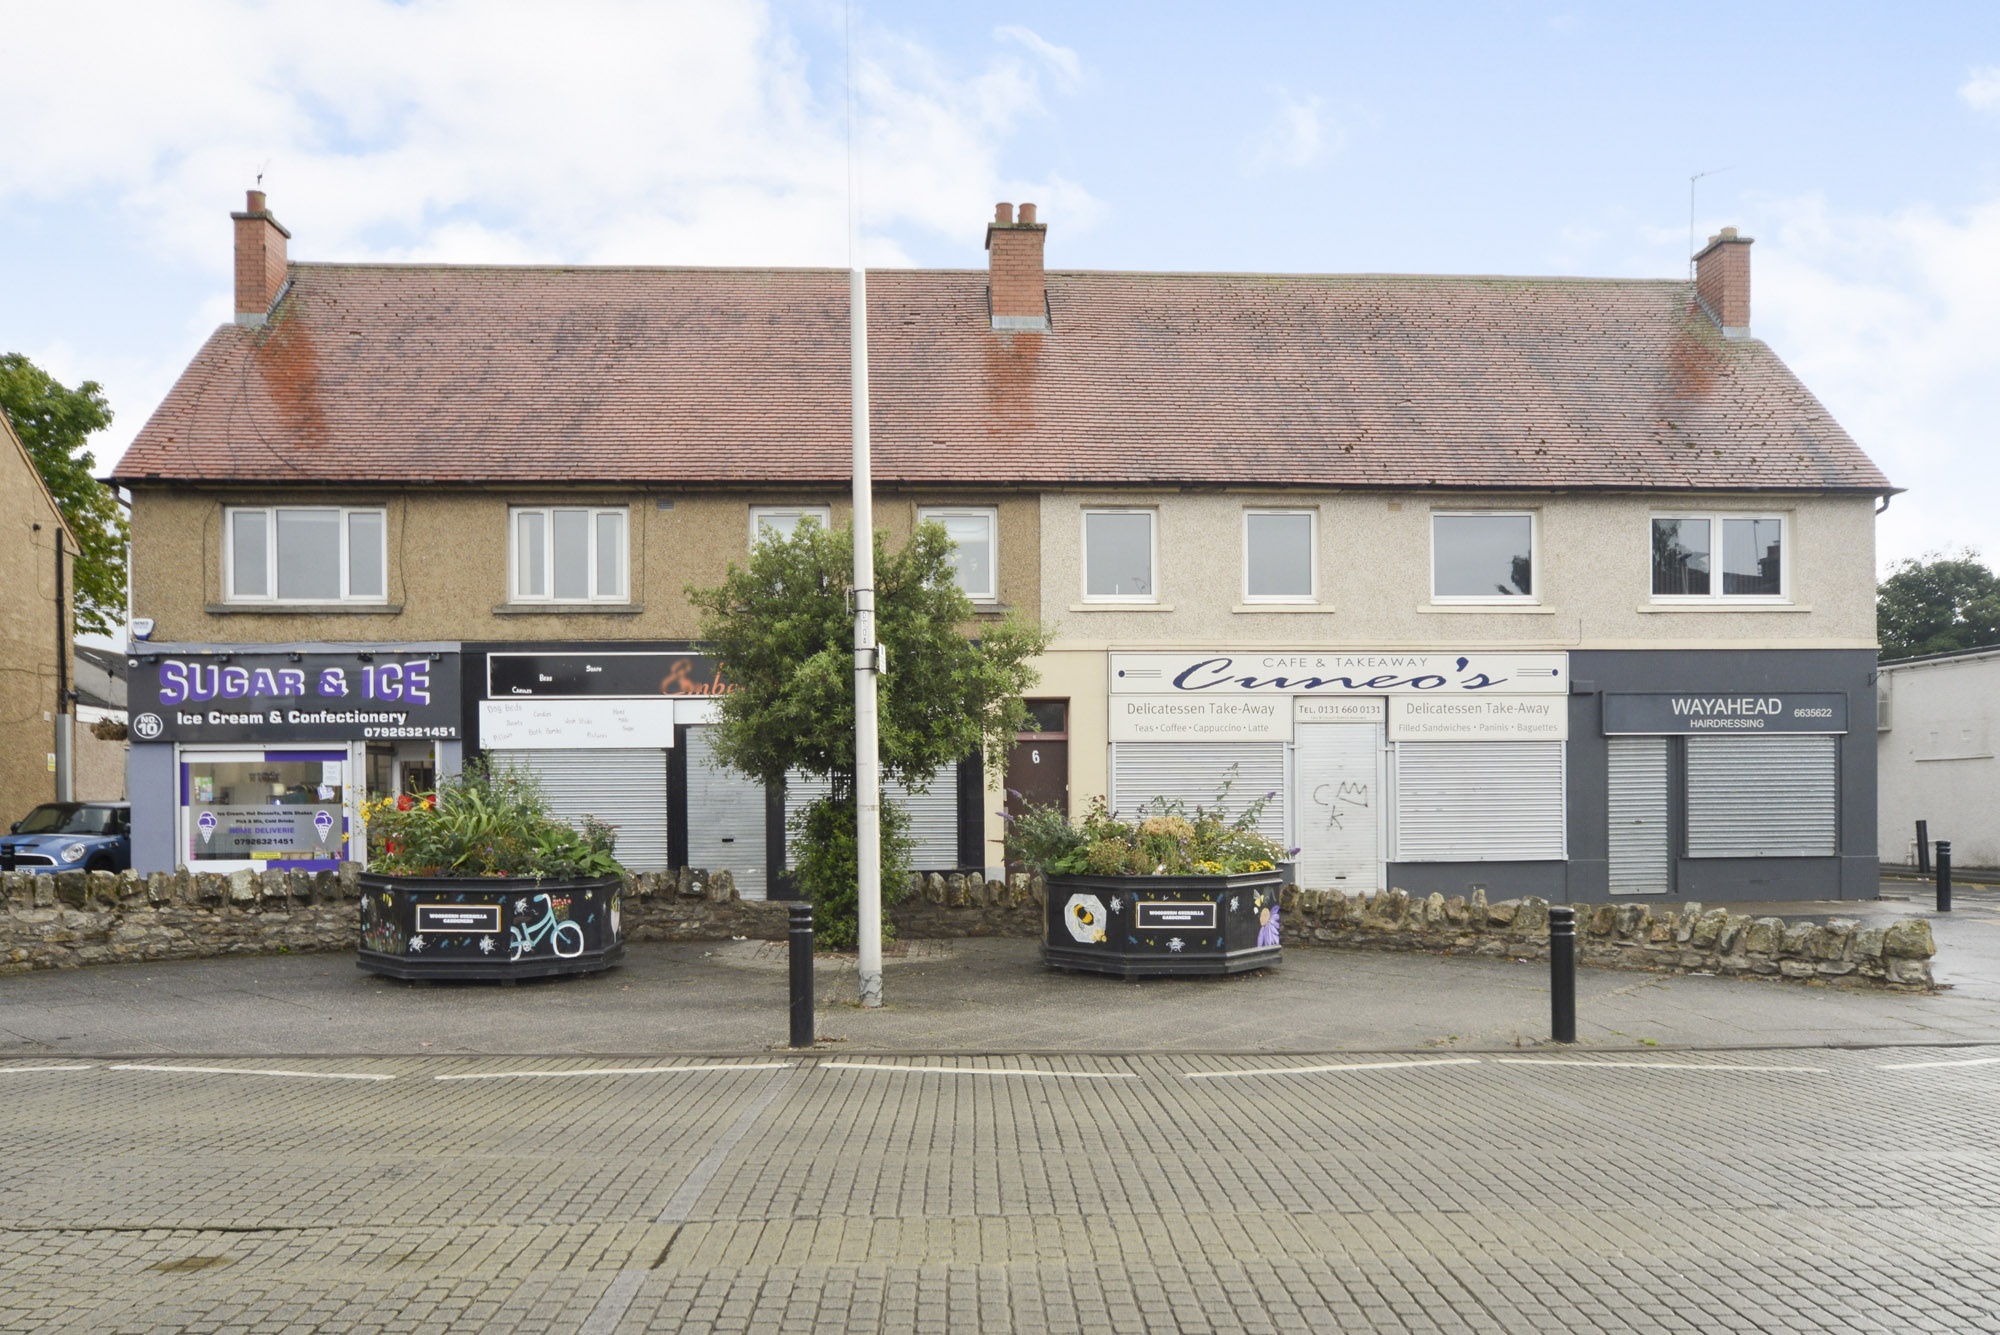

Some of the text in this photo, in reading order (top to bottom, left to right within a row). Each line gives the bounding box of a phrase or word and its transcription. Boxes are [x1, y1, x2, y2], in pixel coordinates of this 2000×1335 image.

[1263, 657, 1428, 668] CAFE & TAKEAWAY
[1172, 656, 1509, 691] Cuneo's
[159, 659, 430, 706] SUGAR & ICE
[1127, 702, 1275, 717] Delicatessen Take-Away
[1318, 705, 1339, 714] 0131
[1341, 705, 1358, 714] 660
[1360, 705, 1381, 714] 0131
[1406, 702, 1550, 716] Delicatessen Take-Away
[1671, 698, 1783, 715] WAYAHEAD
[177, 710, 407, 726] Ice Cream & Confectionery
[1794, 708, 1832, 718] 6635622
[1134, 724, 1269, 734] Teas Coffee Cappuccino Latte
[1399, 724, 1558, 733] Filled Sandwiches Paninis Baguettes
[1690, 719, 1764, 728] HAIRDRESSING
[138, 724, 158, 735] 10
[364, 727, 456, 737] 07926321451
[1031, 750, 1040, 764] 6
